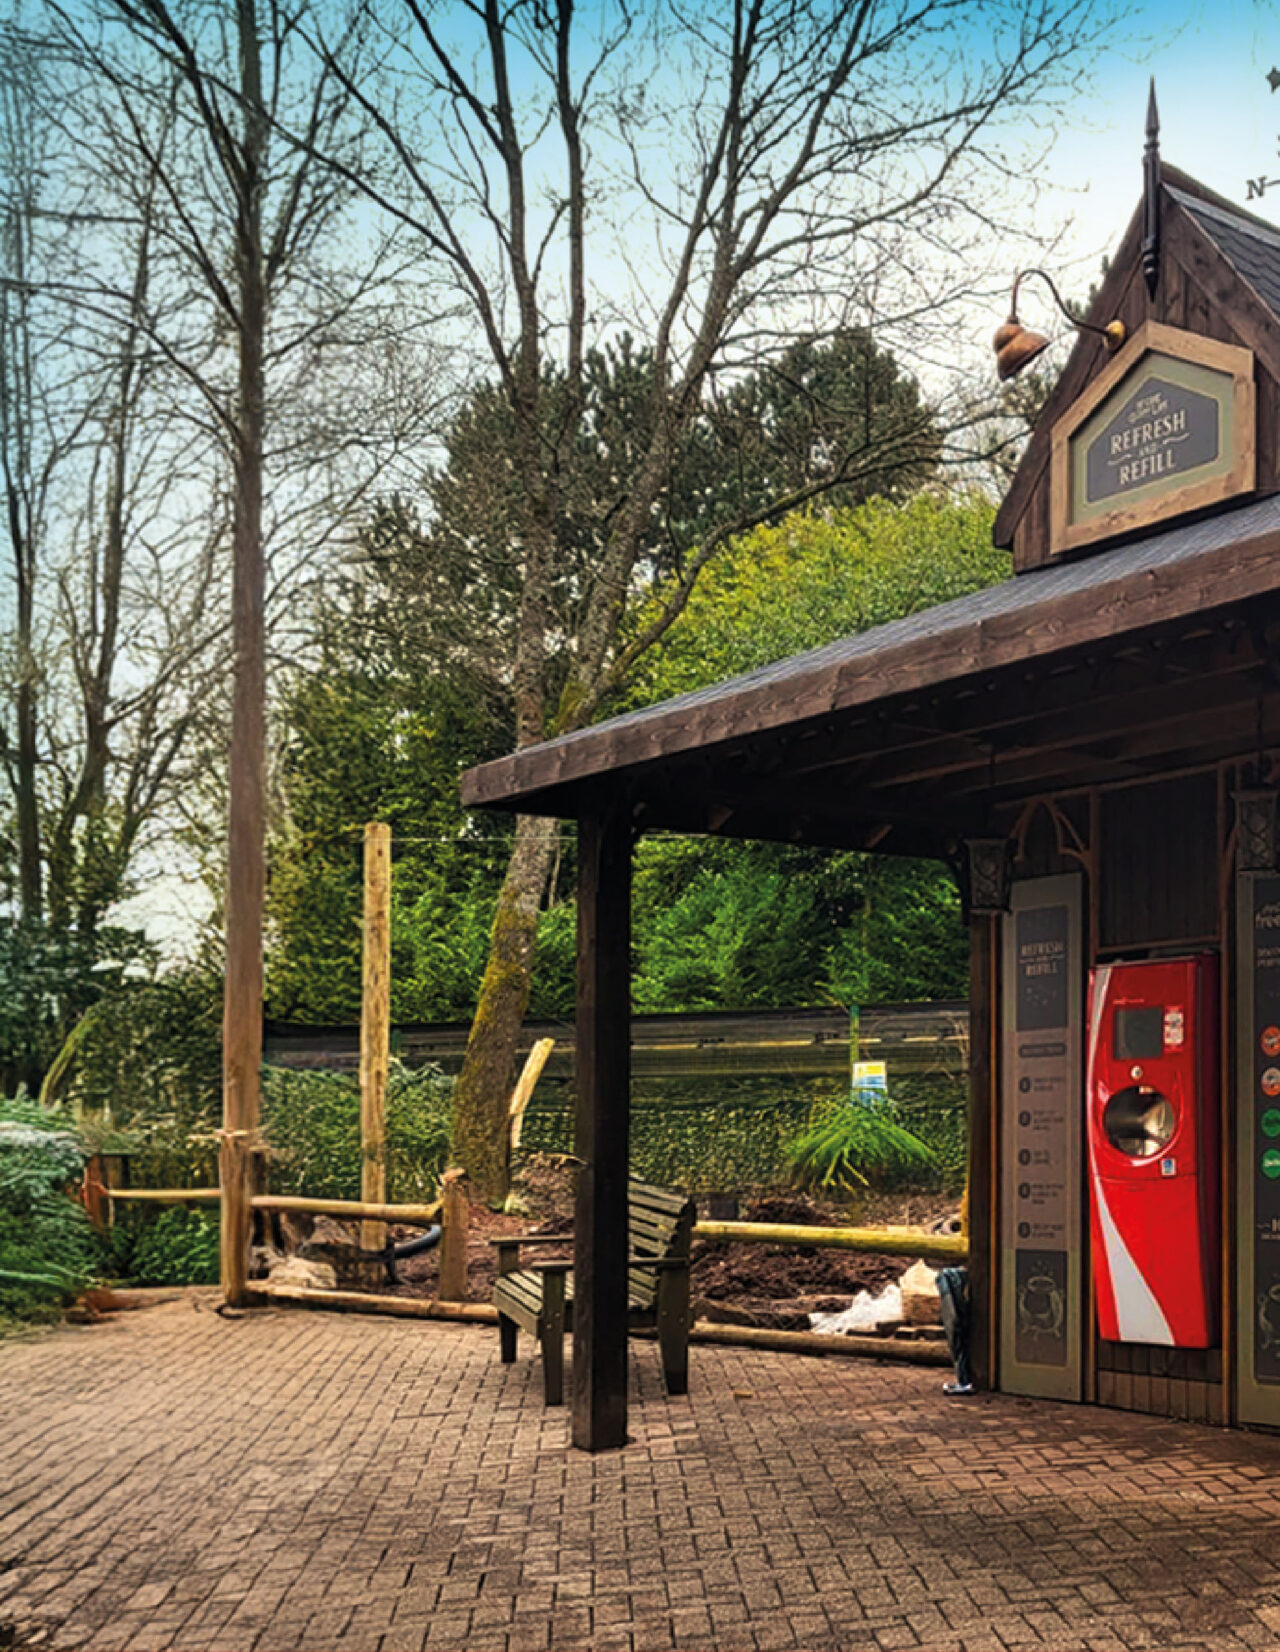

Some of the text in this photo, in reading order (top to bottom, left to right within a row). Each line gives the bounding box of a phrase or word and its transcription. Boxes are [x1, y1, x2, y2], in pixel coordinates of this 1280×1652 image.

[1246, 175, 1267, 201] N
[1110, 409, 1186, 455] REFRESH
[1119, 449, 1177, 485] REFILL
